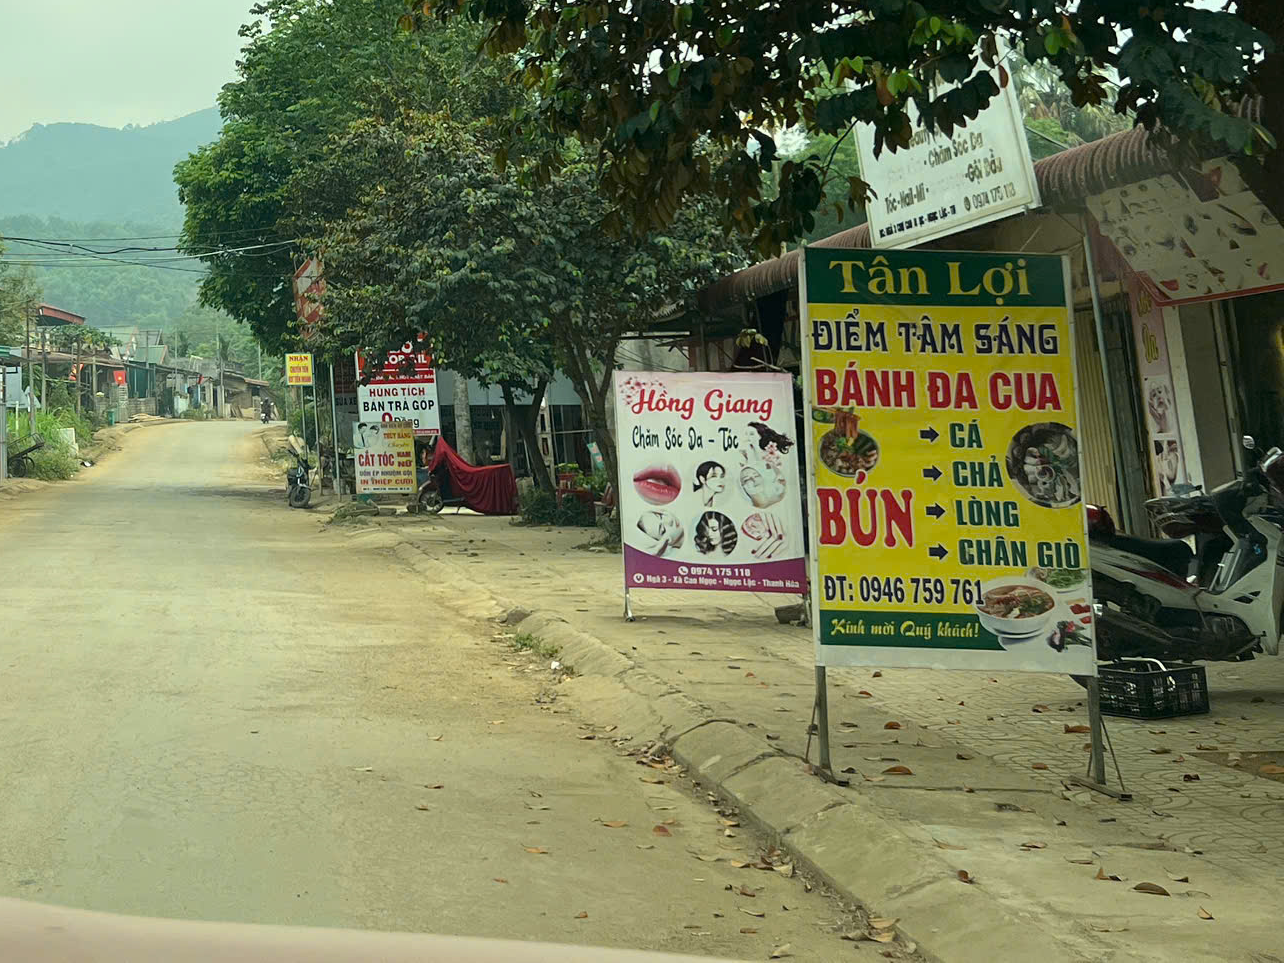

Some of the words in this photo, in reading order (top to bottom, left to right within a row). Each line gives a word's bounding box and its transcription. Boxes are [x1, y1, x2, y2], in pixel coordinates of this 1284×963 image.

[928, 145, 952, 168] Chăm
[952, 133, 968, 157] Sóc
[829, 255, 930, 296] Tân
[947, 258, 1032, 306] Lợi
[812, 309, 888, 352] ĐIỂM
[898, 315, 964, 354] TÂM
[974, 316, 1058, 355] SÁNG
[816, 361, 916, 408] BÁNH
[927, 372, 979, 410] ĐA
[990, 372, 1062, 411] CUA
[631, 388, 695, 420] Hồng
[704, 389, 773, 421] Giang
[632, 425, 660, 449] Chăm
[665, 425, 683, 450] Sóc
[688, 427, 703, 450] Da
[718, 427, 739, 451] Tóc
[949, 419, 983, 449] CÁ
[358, 450, 375, 467] CẮT
[377, 451, 395, 467] TÓC
[952, 455, 1004, 487] CHẢ
[816, 470, 914, 548] BÚN
[955, 496, 1020, 528] LÒNG
[959, 536, 1027, 567] CHÂN
[1037, 538, 1080, 569] GIÒ
[690, 567, 713, 575] 0974
[715, 568, 732, 576] 175
[824, 575, 854, 601] ĐT:
[860, 577, 905, 603] 0946
[911, 578, 945, 605] 759
[951, 579, 985, 606] 761
[830, 618, 865, 637] Kính
[871, 620, 894, 636] mời
[900, 620, 932, 640] Quý
[937, 621, 980, 638] khách!
